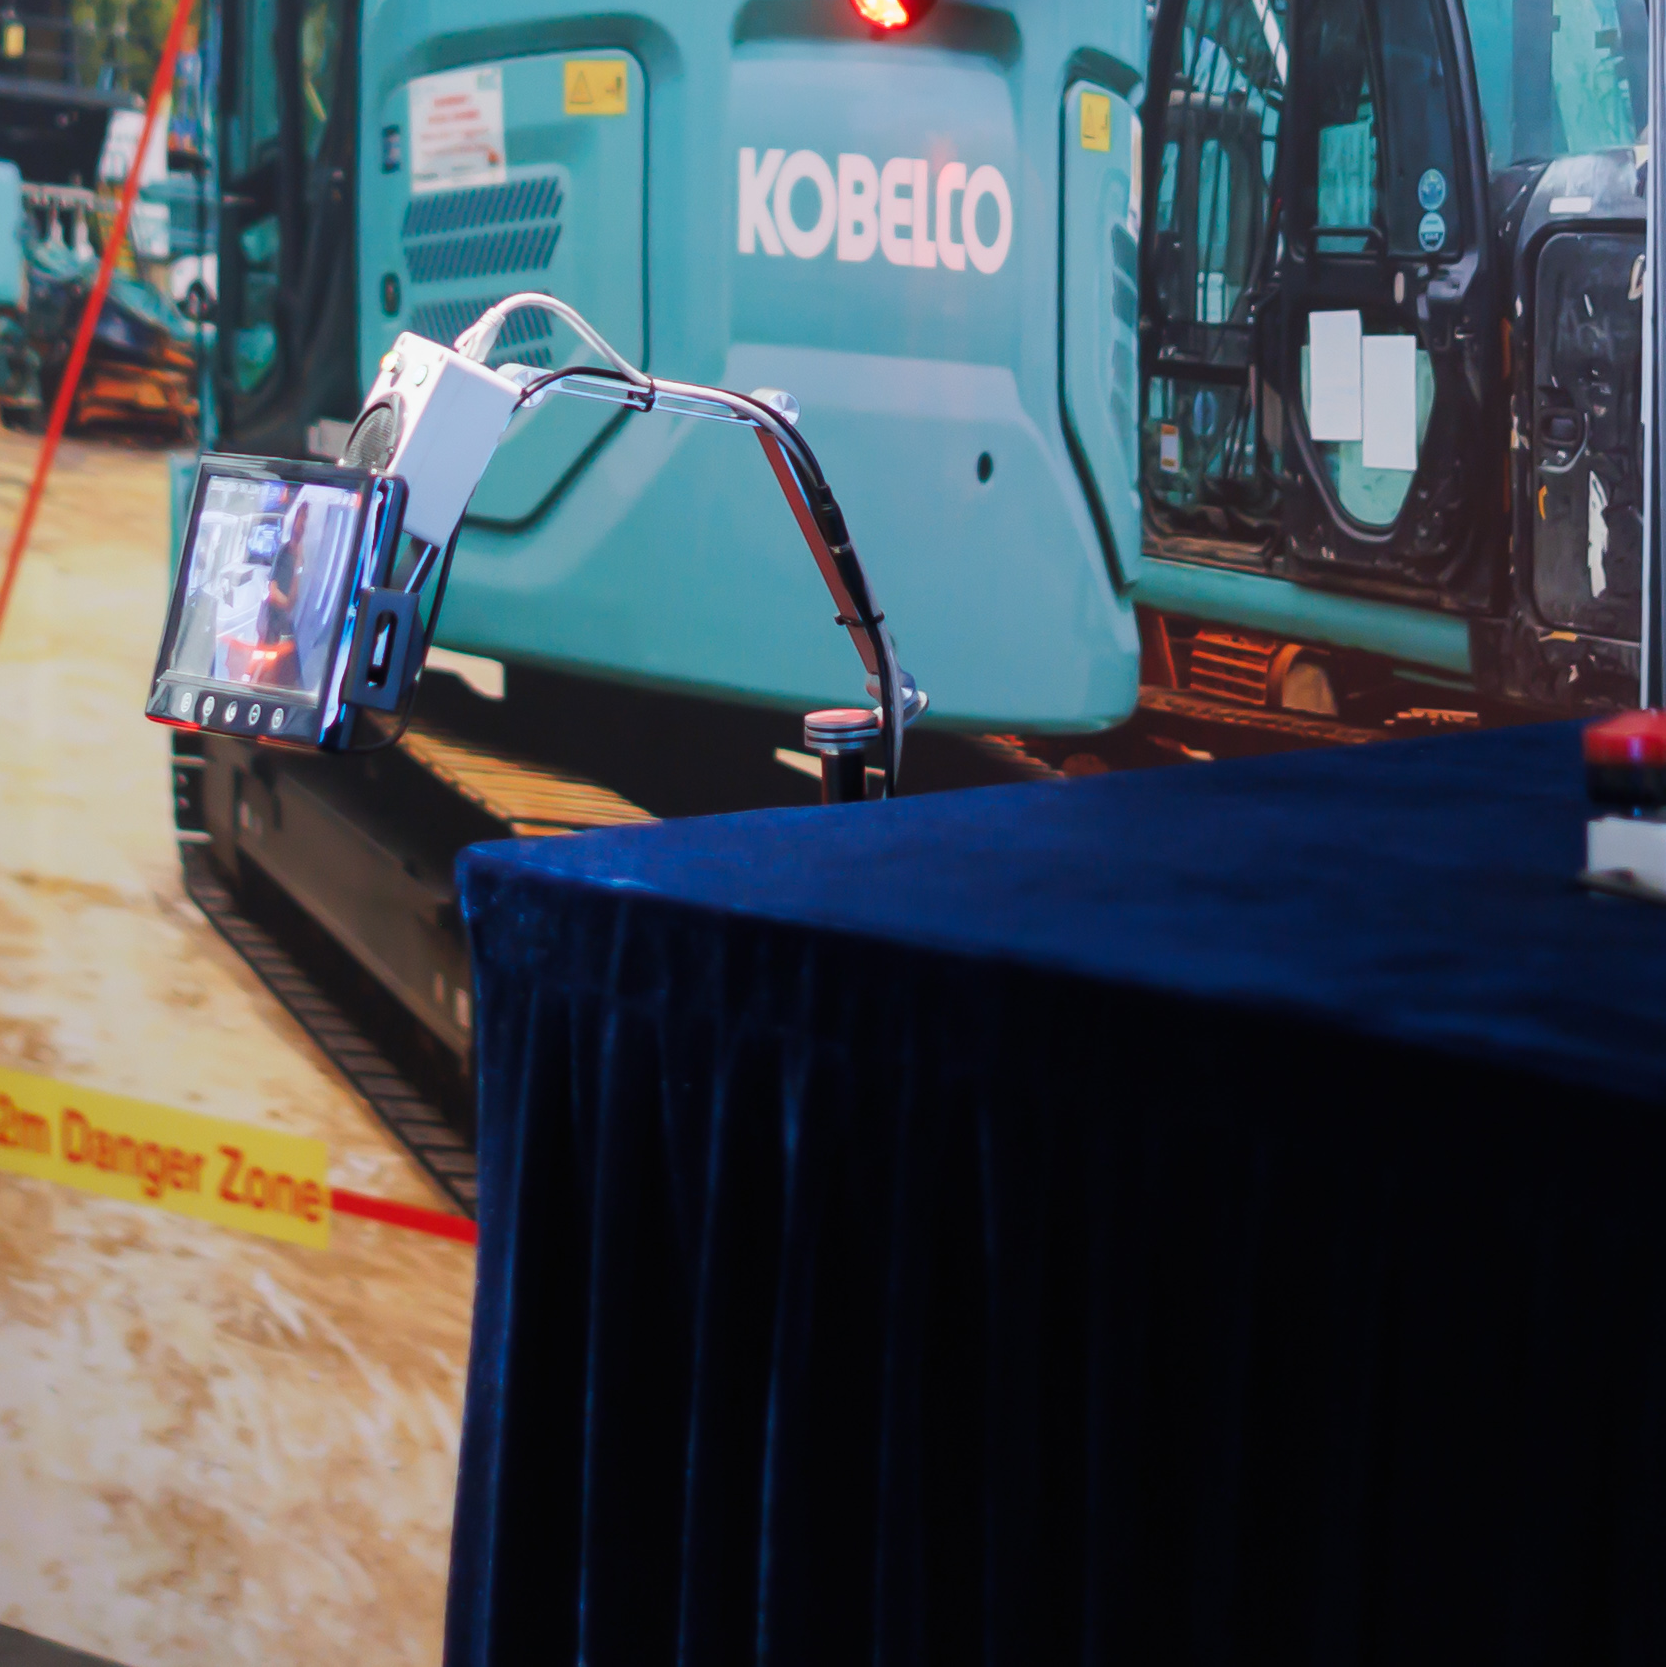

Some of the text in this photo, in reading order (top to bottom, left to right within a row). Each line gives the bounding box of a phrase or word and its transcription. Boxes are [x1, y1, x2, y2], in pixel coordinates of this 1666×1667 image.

[738, 147, 1012, 274] KOBELCO
[61, 1107, 206, 1200] Danger
[218, 1145, 323, 1223] Zone
